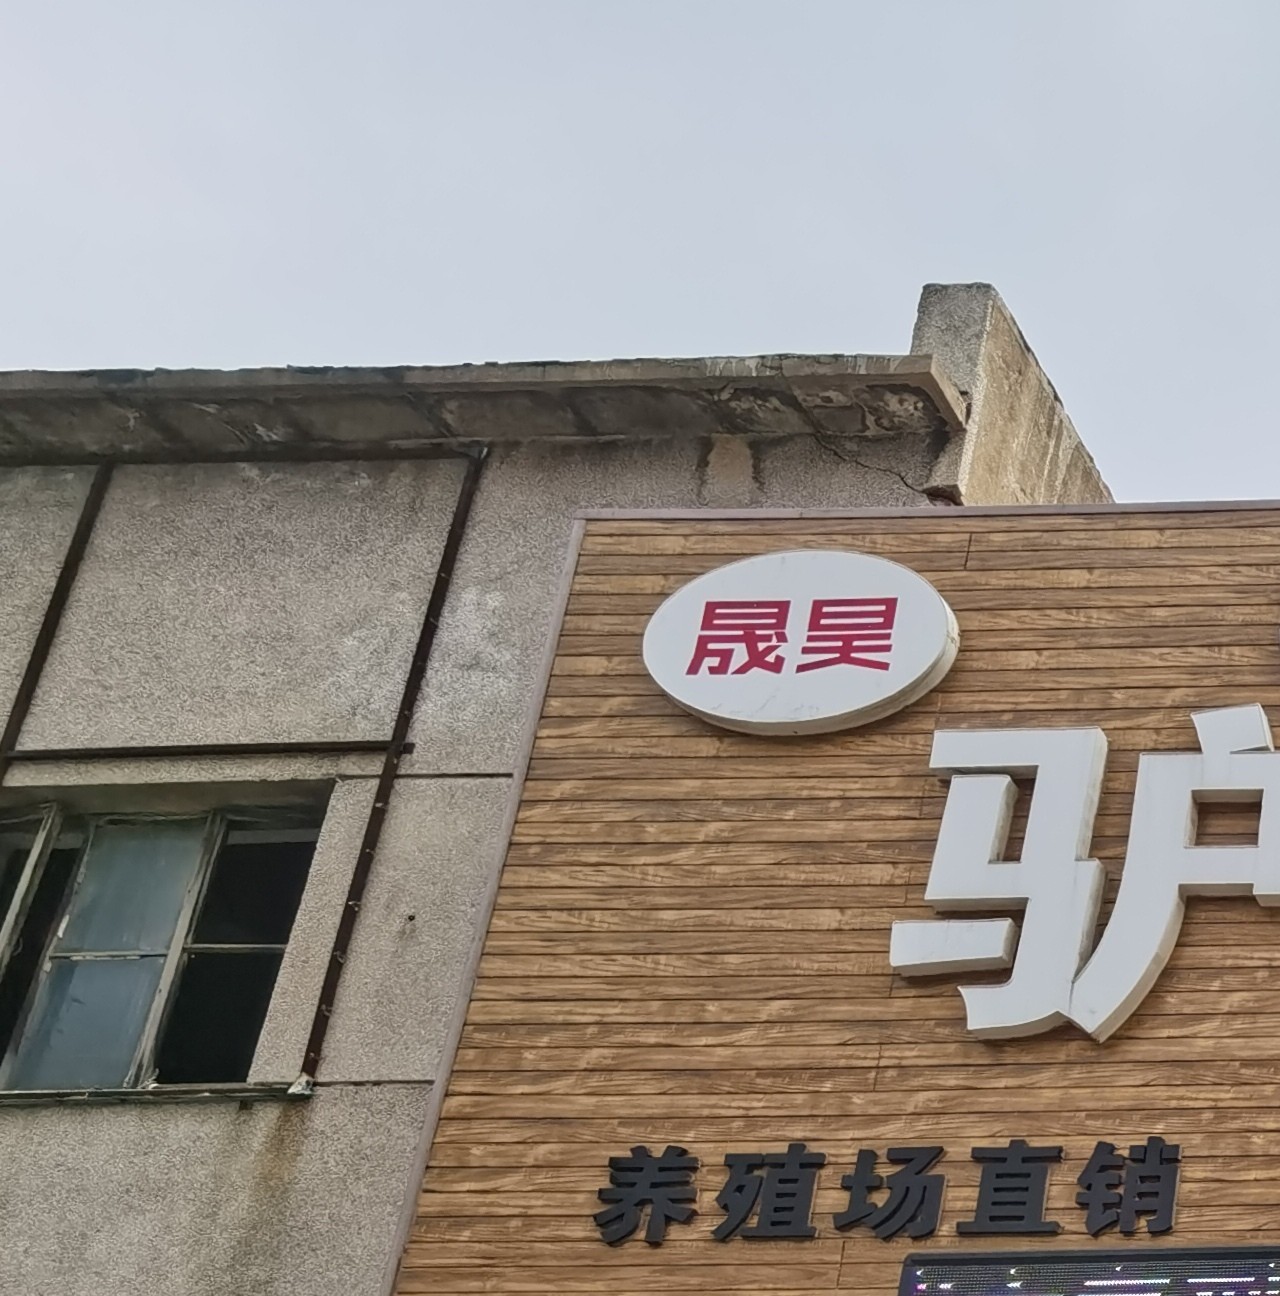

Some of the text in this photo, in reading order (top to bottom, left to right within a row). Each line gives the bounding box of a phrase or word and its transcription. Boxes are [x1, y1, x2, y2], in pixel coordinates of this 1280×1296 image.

[686, 597, 899, 676] 晟昊
[594, 1135, 1181, 1245] 养殖场直销
